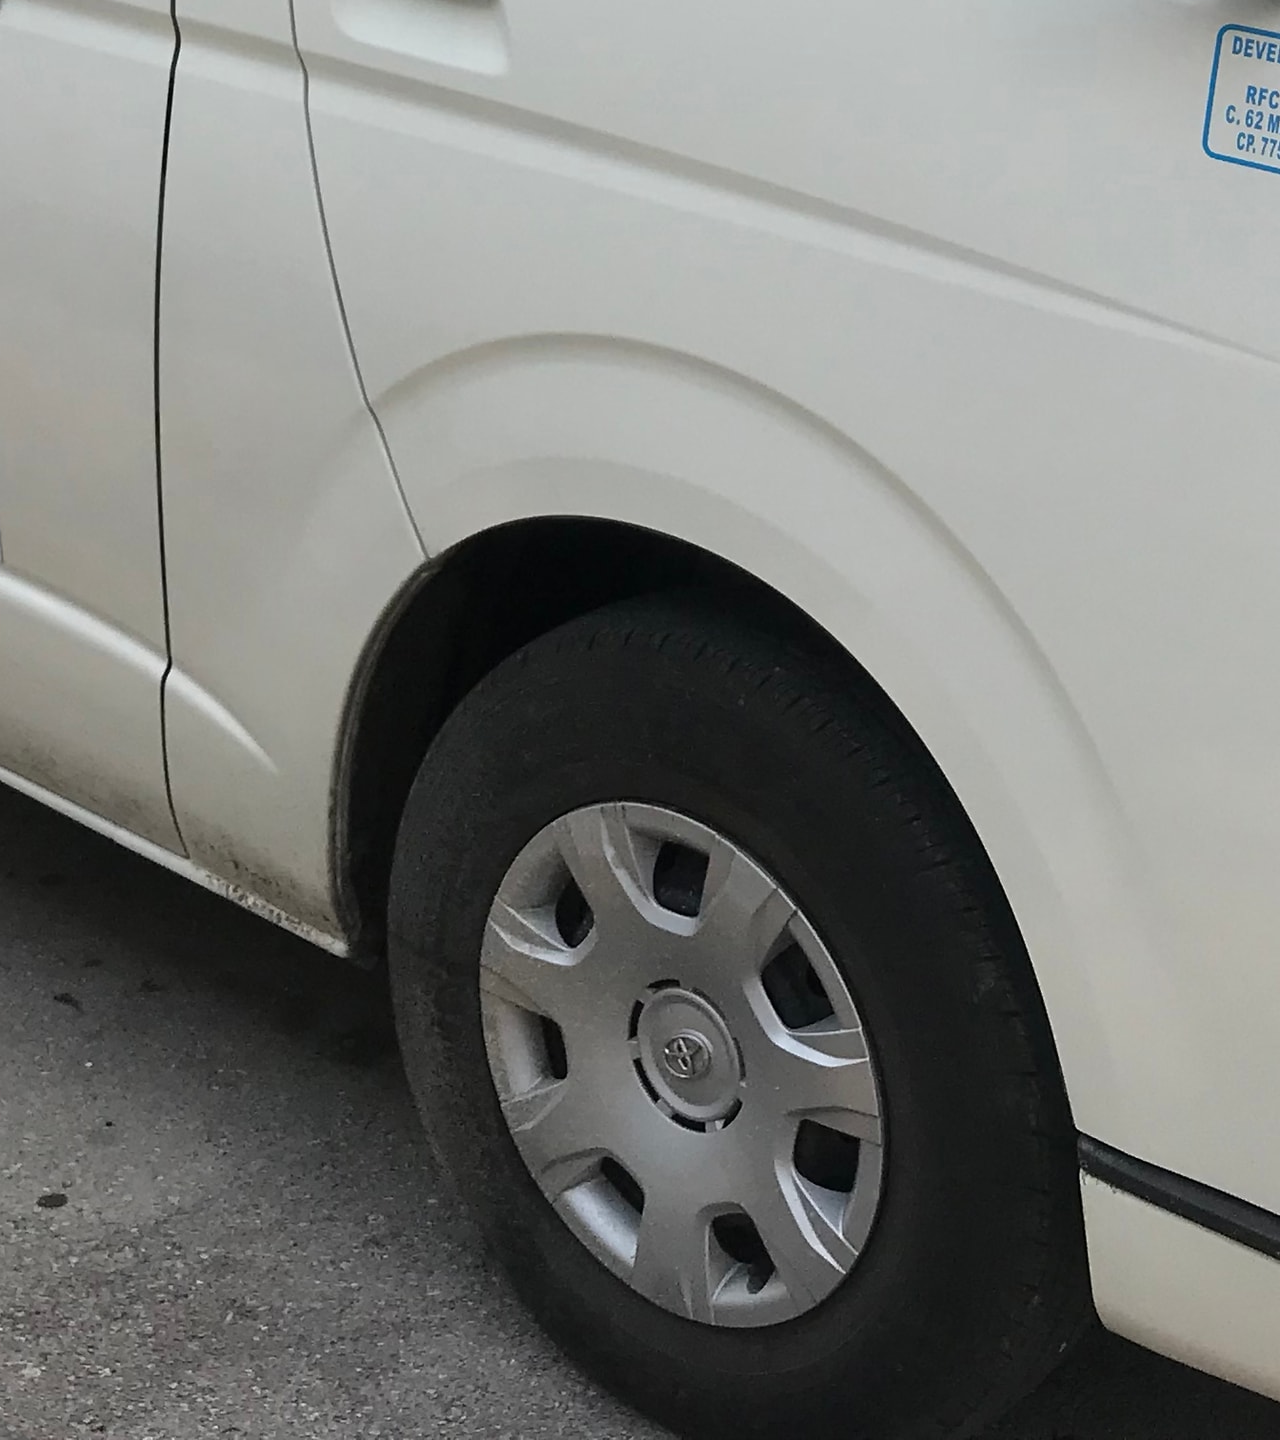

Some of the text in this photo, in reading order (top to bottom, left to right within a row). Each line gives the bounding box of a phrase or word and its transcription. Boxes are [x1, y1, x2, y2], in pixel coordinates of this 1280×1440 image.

[1225, 104, 1240, 126] C.
[1245, 109, 1263, 130] 62
[1236, 131, 1256, 154] CP.
